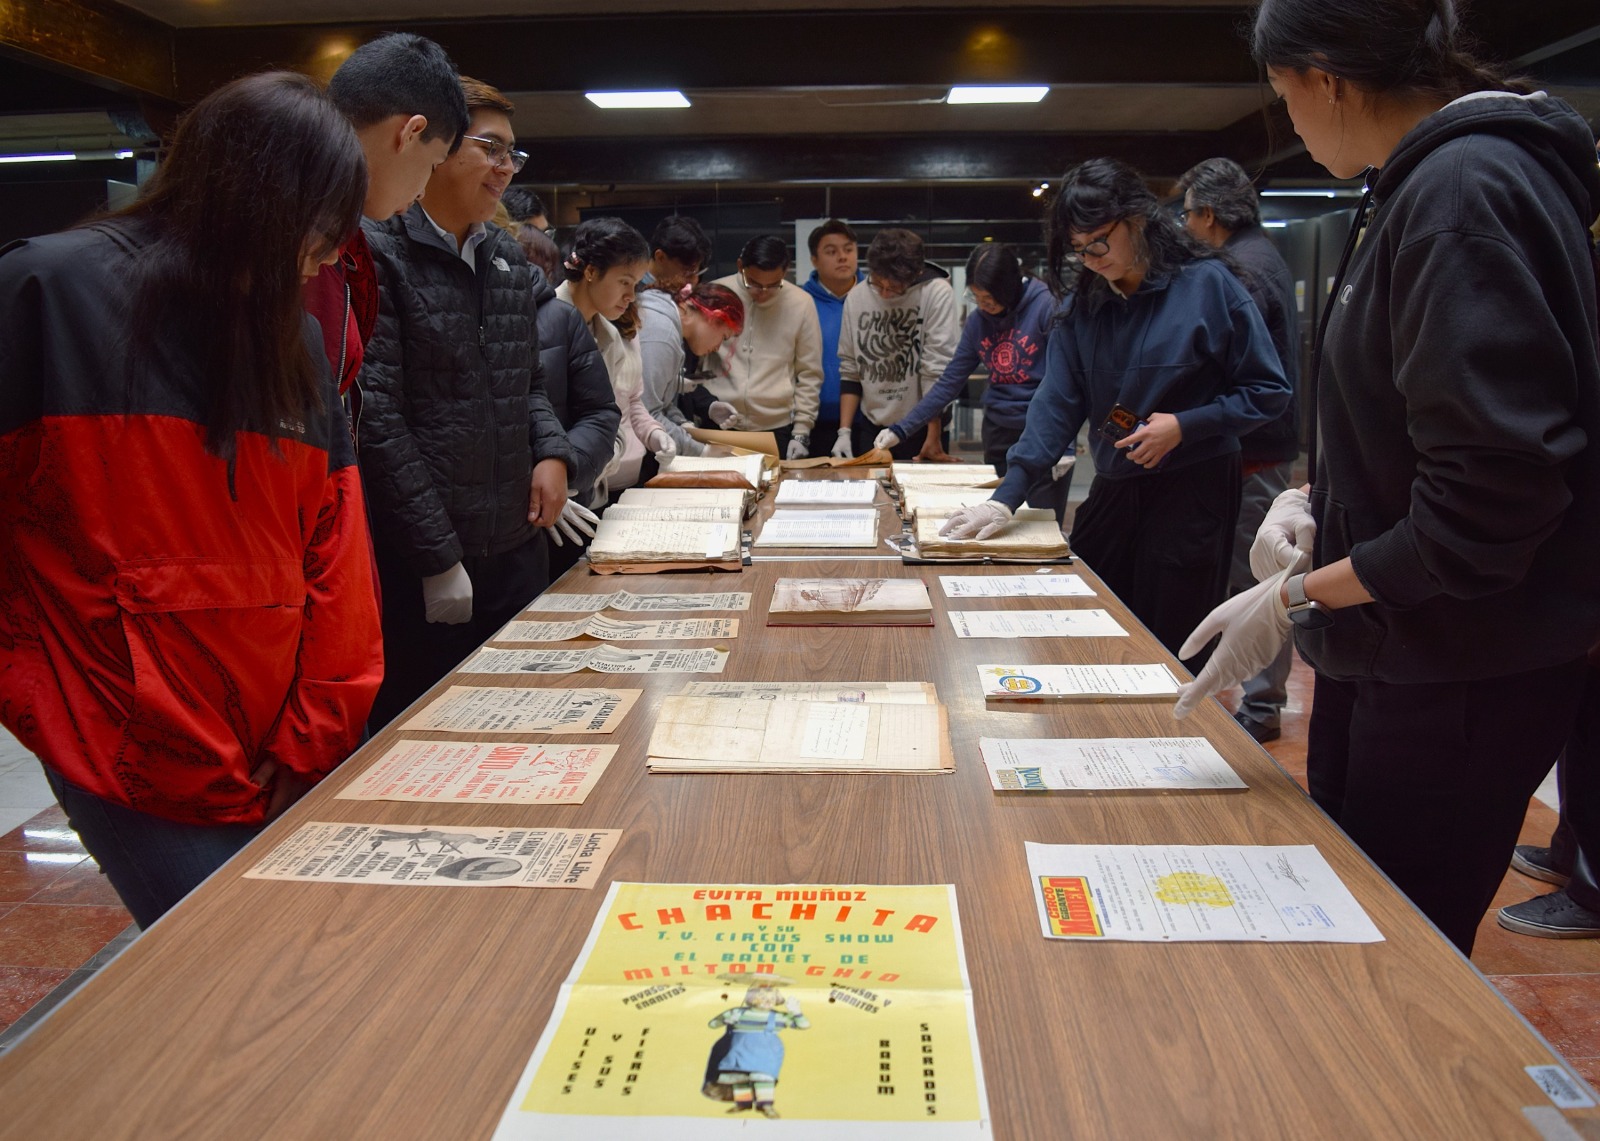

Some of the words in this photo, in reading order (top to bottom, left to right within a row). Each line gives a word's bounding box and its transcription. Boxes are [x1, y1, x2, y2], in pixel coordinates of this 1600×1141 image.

[978, 328, 1038, 356] AMIAN
[475, 746, 529, 769] SANTO
[483, 836, 504, 850] KATO
[514, 837, 543, 855] FARAON
[577, 832, 609, 857] Lucha
[389, 861, 419, 880] AMERICO
[408, 871, 433, 880] LEE
[562, 861, 593, 883] Libre
[692, 890, 762, 901] EVITA
[776, 888, 866, 902] MUÑOZ
[1048, 877, 1097, 934] MODELO
[1054, 887, 1070, 919] GIGANTE
[617, 903, 939, 934] CHACHITA
[658, 931, 670, 941] T.
[680, 931, 698, 941] V.
[716, 933, 800, 943] CIRCUS
[825, 934, 894, 943] SHOW
[750, 944, 794, 952] CON
[674, 952, 697, 962] EL
[721, 953, 812, 963] BALLET
[840, 954, 868, 964] DE
[622, 963, 774, 980] MILTON
[805, 966, 901, 982] GHIO
[635, 986, 686, 1010] ENANITOS
[830, 982, 878, 1002] ASOS
[884, 998, 892, 1007] Y
[830, 989, 879, 1014] ENANITOS
[561, 1026, 597, 1095] ULISES
[621, 1027, 650, 1096] FIERAS
[920, 1022, 936, 1116] SAGRADOS
